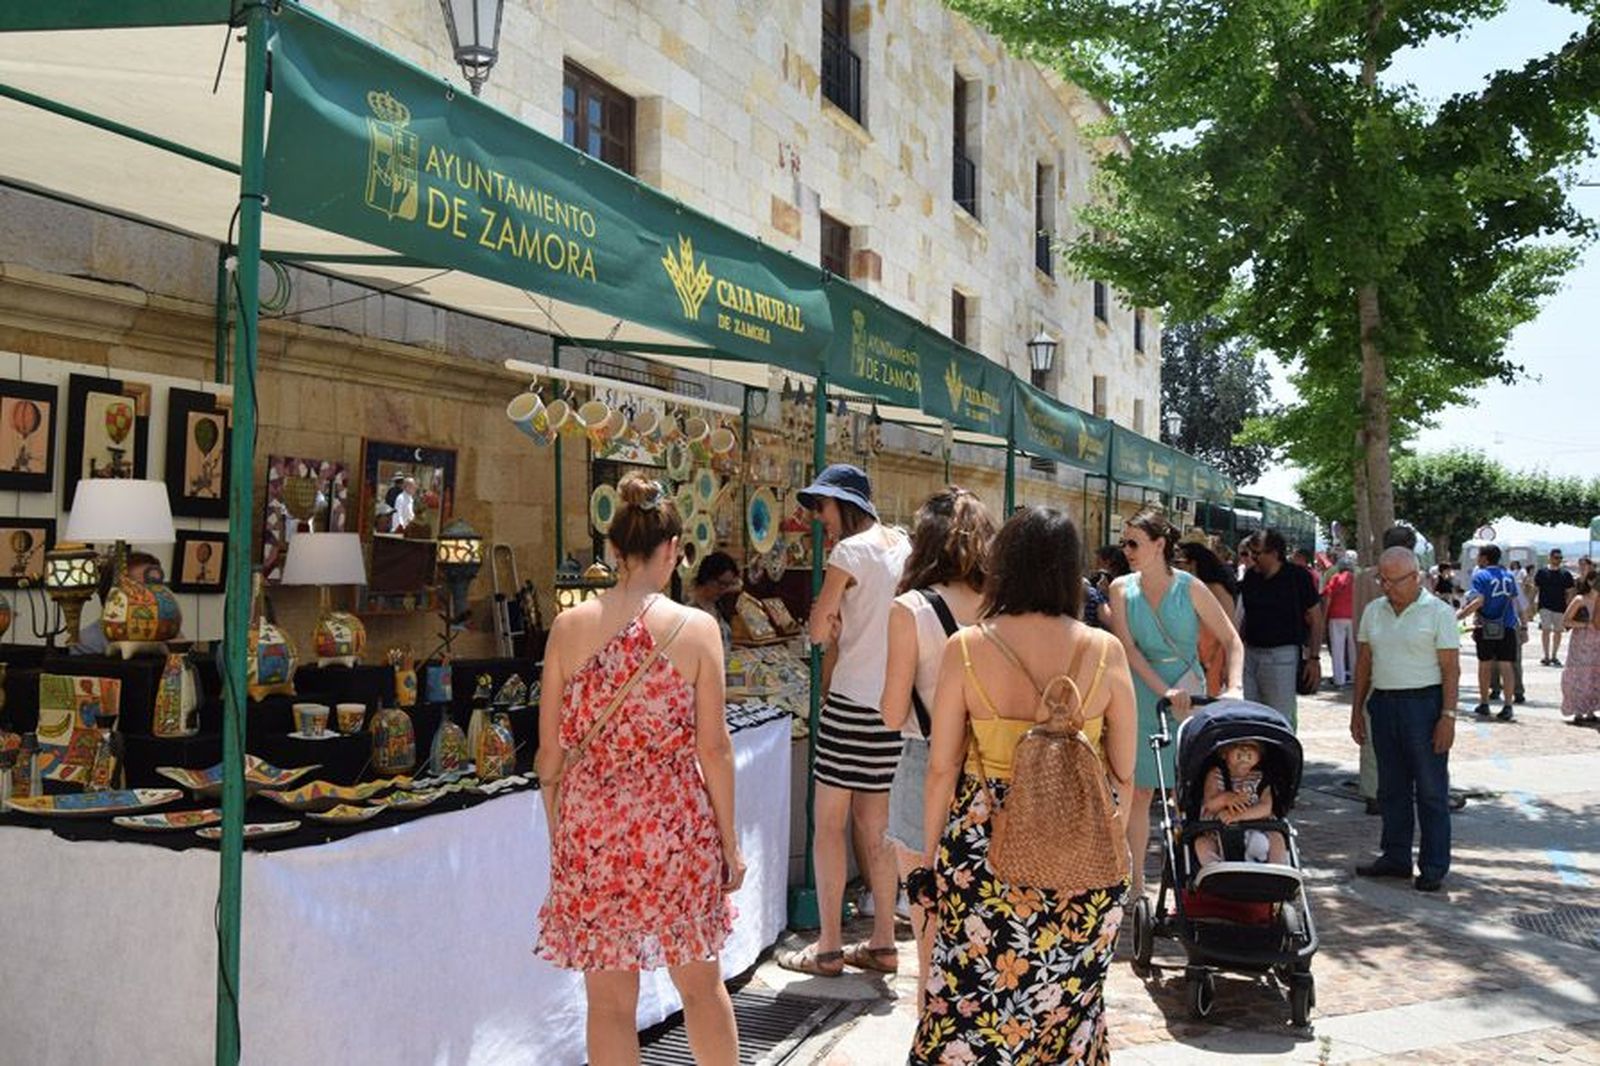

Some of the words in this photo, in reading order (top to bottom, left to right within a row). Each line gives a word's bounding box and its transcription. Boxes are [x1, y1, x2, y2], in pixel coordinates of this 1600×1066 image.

[425, 146, 597, 239] AYUNTAMIENTO
[427, 187, 468, 240] DE
[479, 208, 597, 284] ZAMORA
[716, 279, 756, 317] CAJA
[754, 292, 805, 333] RURAL
[718, 313, 732, 331] DE
[734, 318, 772, 345] ZAMORA
[866, 357, 880, 382] DE
[881, 363, 922, 393] ZAMOR
